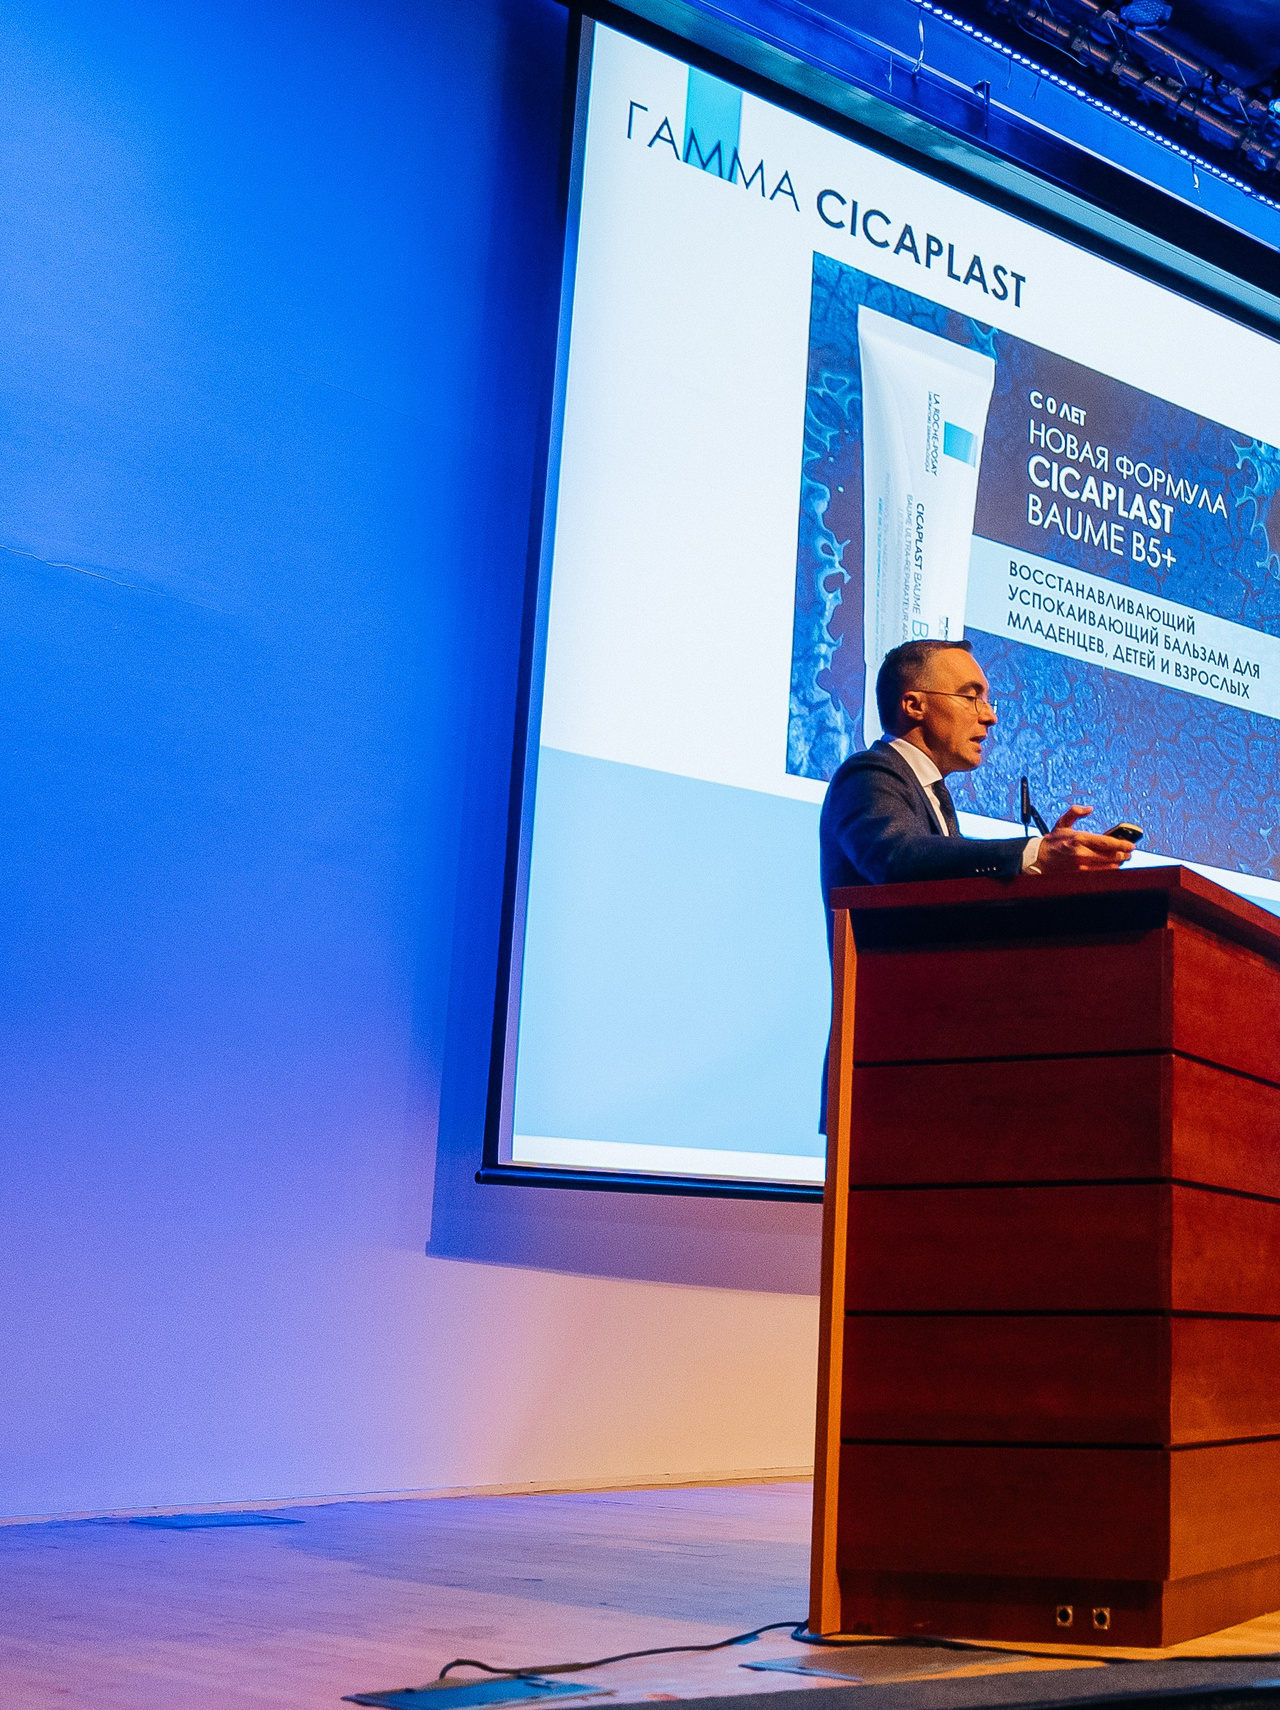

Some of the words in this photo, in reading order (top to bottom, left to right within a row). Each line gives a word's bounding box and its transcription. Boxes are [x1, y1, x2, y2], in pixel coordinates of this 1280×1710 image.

[627, 100, 800, 212] ГАММА
[816, 189, 1026, 308] CICAPLAST
[1059, 404, 1087, 427] ЛЕТ
[1028, 455, 1174, 533] CICAPLAST
[1029, 418, 1109, 472] НОВАЯ
[1116, 455, 1228, 519] ФОРМУЛА
[914, 503, 925, 570] CICAPLAST
[1027, 493, 1124, 556] BAUME
[1132, 537, 1176, 569] B5+
[912, 572, 922, 615] BAUME
[912, 620, 929, 641] B
[1008, 584, 1159, 647] УСПОКАИВАЮЩИЙ
[1164, 635, 1230, 670] БАЛЬЗАМ
[1232, 658, 1261, 679] ДЛЯ
[1009, 560, 1196, 635] ВОССТАНАВЛИВАЮЩИЙ
[1007, 611, 1108, 657] МЛАДЕНЦЕВ,
[1112, 644, 1156, 671] ДЕТЕЙ
[1161, 658, 1170, 675] И
[1175, 662, 1250, 699] ВЗРОСЛЫХ
